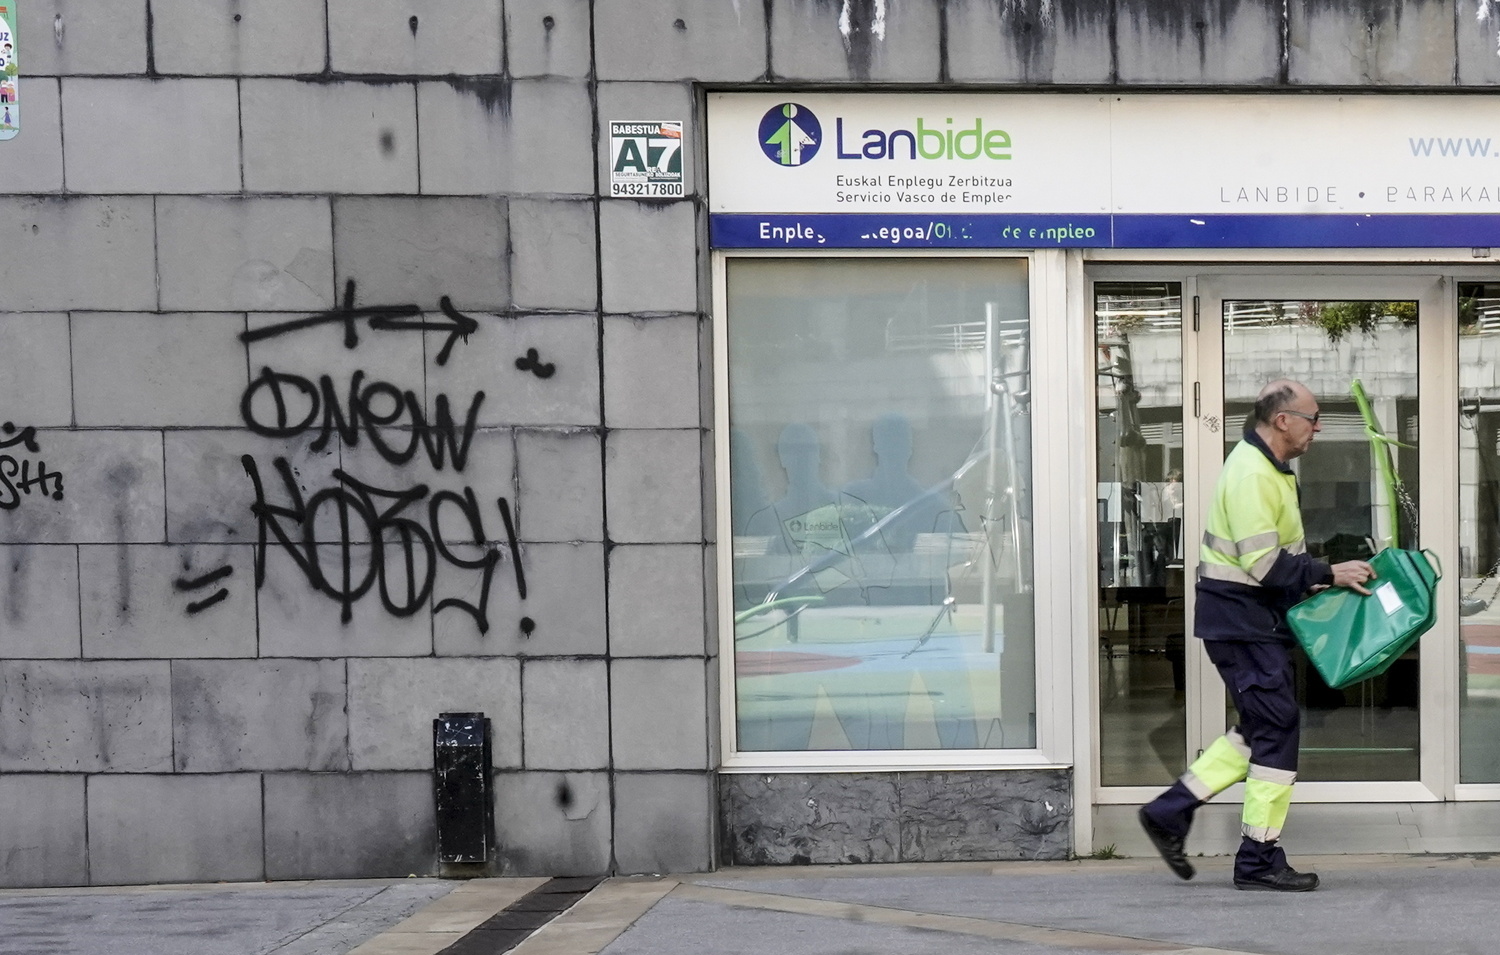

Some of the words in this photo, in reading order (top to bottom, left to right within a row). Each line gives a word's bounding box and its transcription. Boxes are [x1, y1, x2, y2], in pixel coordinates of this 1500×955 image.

[612, 125, 661, 135] BABESTUA
[836, 117, 1012, 160] Lanbide
[612, 183, 682, 195] 943217800
[836, 175, 882, 187] Euskal
[888, 175, 943, 190] Enplegu
[948, 175, 1013, 187] Zerbitzua
[836, 191, 891, 203] Servicio
[896, 191, 935, 203] Vasco
[940, 191, 957, 203] de
[1220, 186, 1338, 203] LANBIDE
